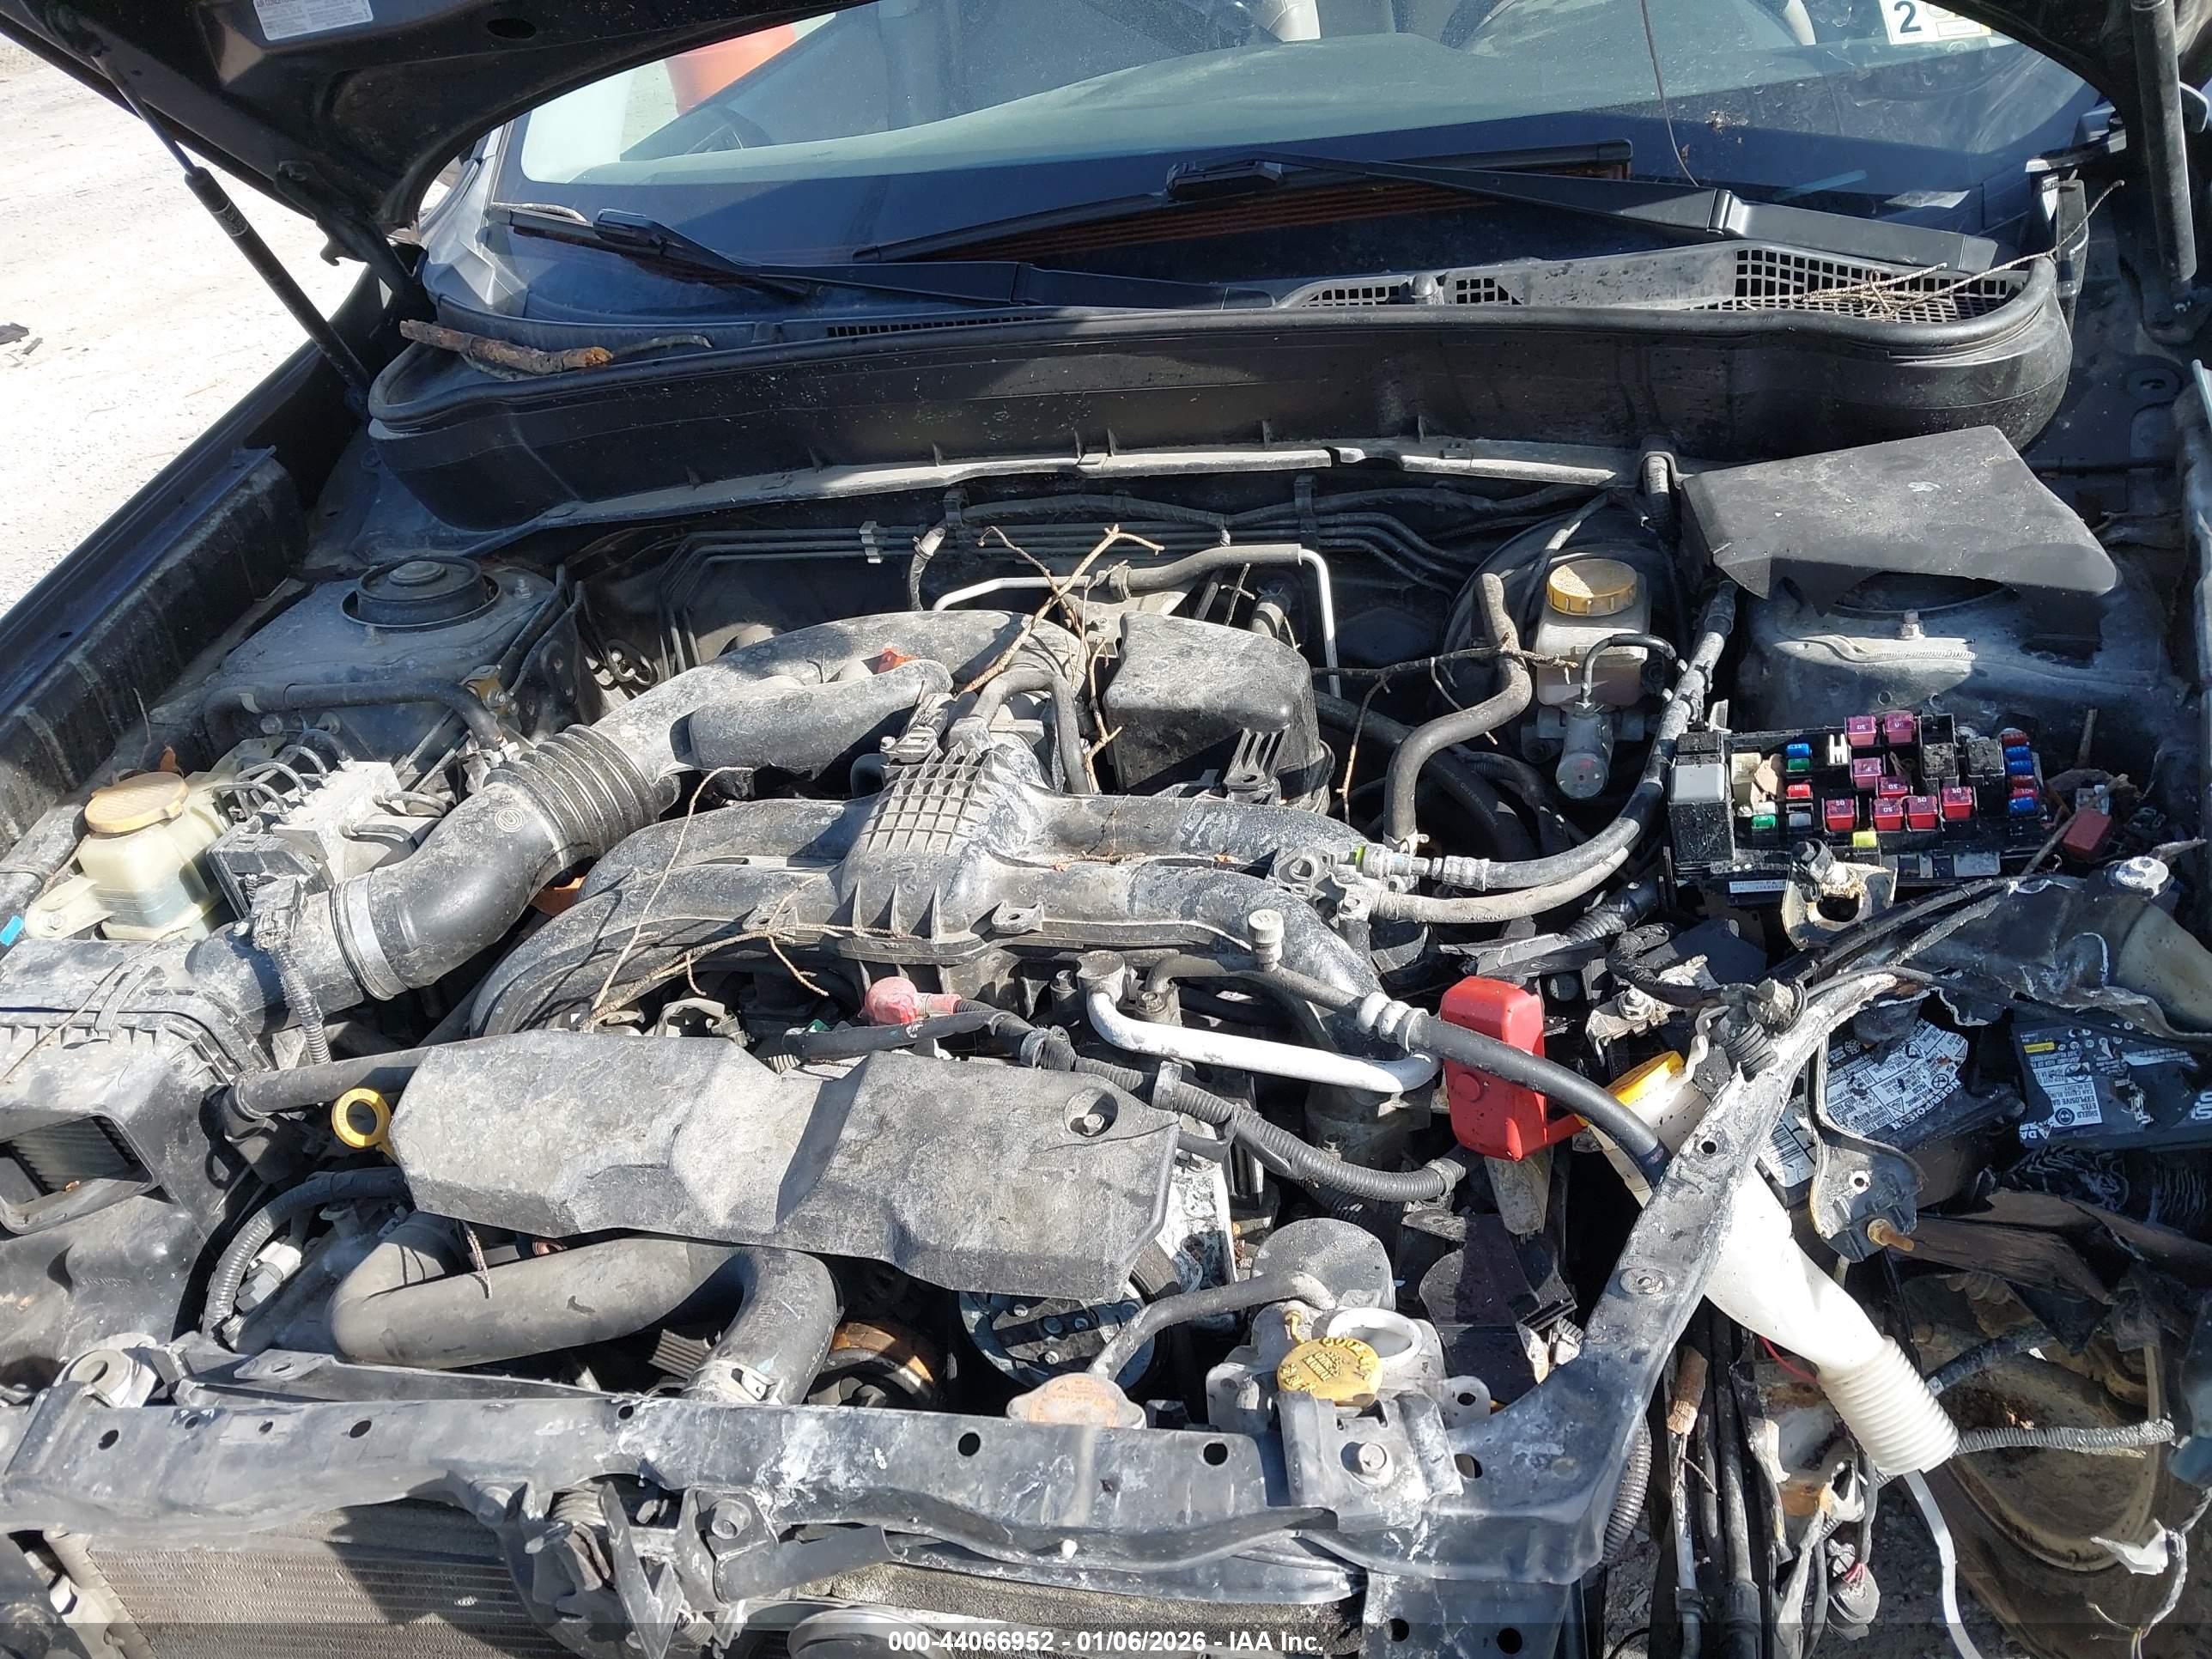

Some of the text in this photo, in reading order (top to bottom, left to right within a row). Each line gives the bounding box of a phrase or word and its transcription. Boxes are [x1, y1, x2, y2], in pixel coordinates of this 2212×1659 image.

[1894, 0, 1923, 34] 2
[2060, 1095, 2095, 1104] EXPLOSIVE
[2076, 1110, 2099, 1119] SHIELD
[1875, 1115, 1893, 1127] FLUSH
